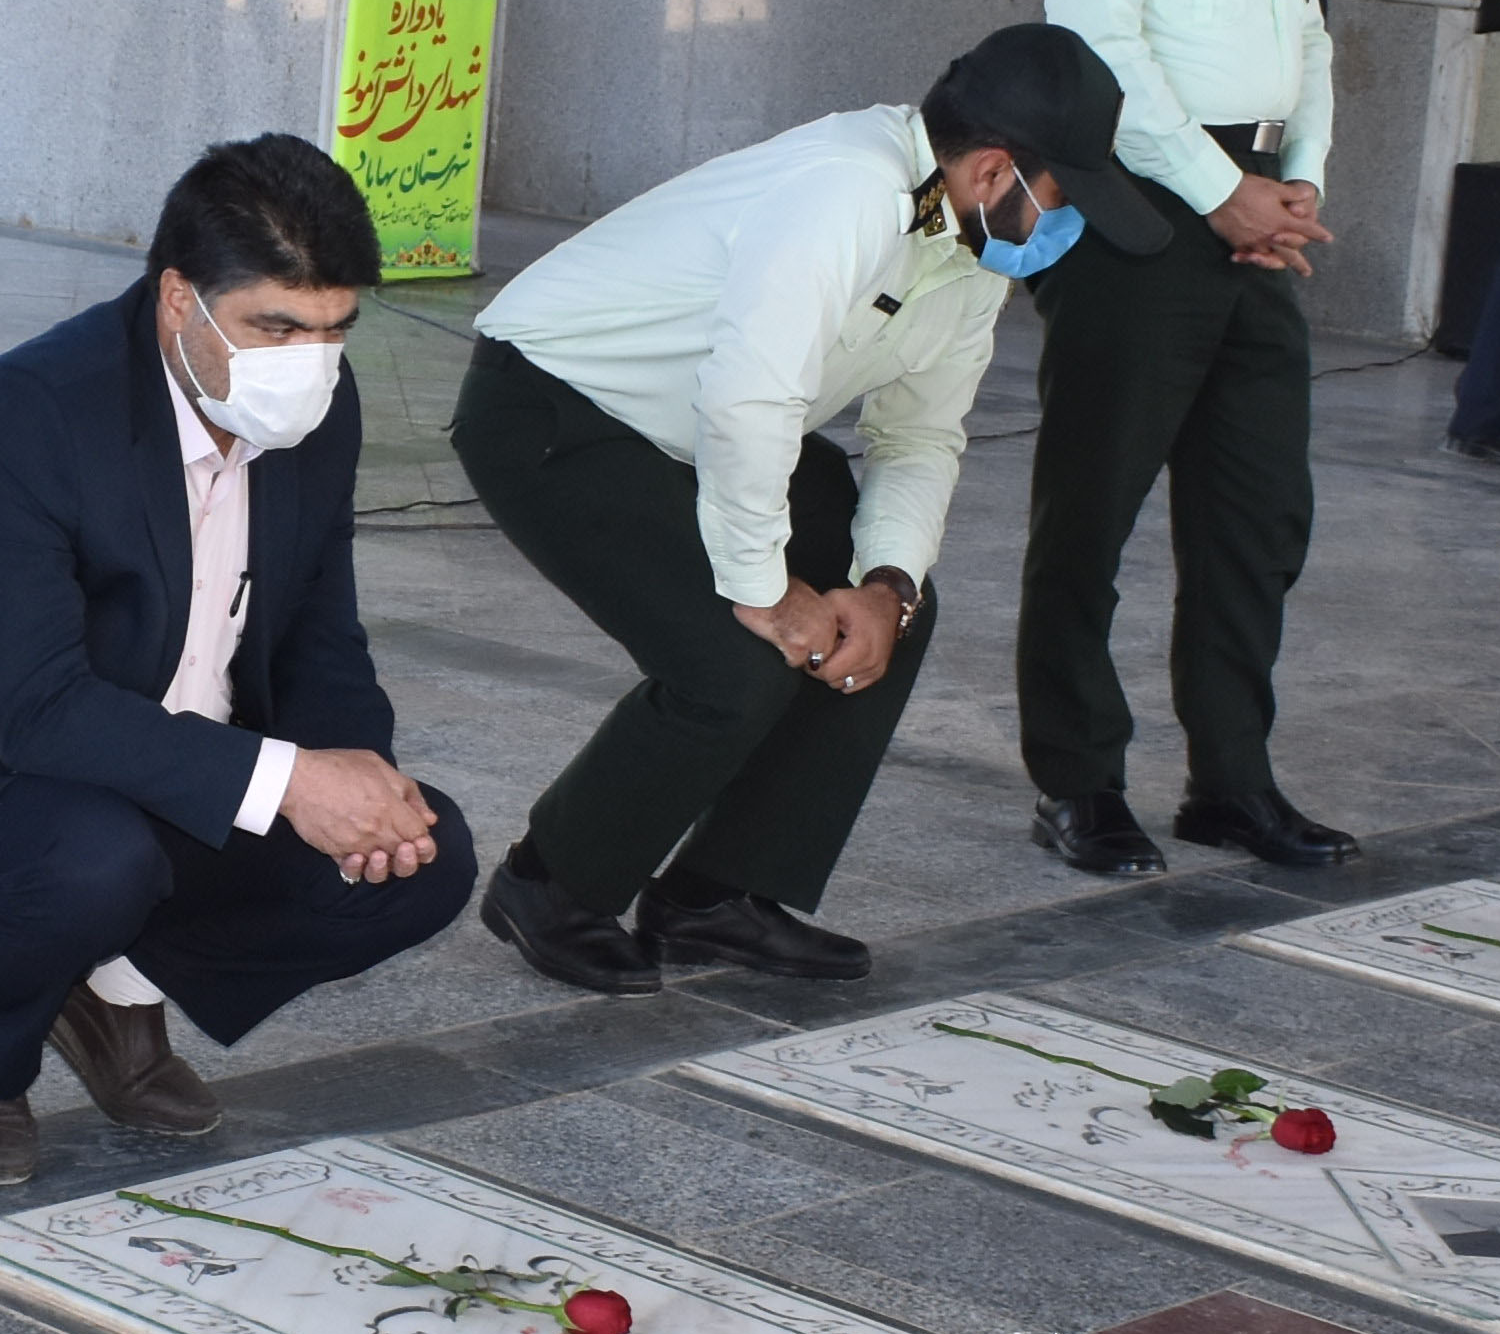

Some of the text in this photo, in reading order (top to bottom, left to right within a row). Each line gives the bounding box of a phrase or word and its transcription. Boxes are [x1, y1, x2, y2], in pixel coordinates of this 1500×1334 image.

[337, 41, 481, 143] شهدای دانش آموز
[354, 131, 472, 200] شهرستان بهاباد
